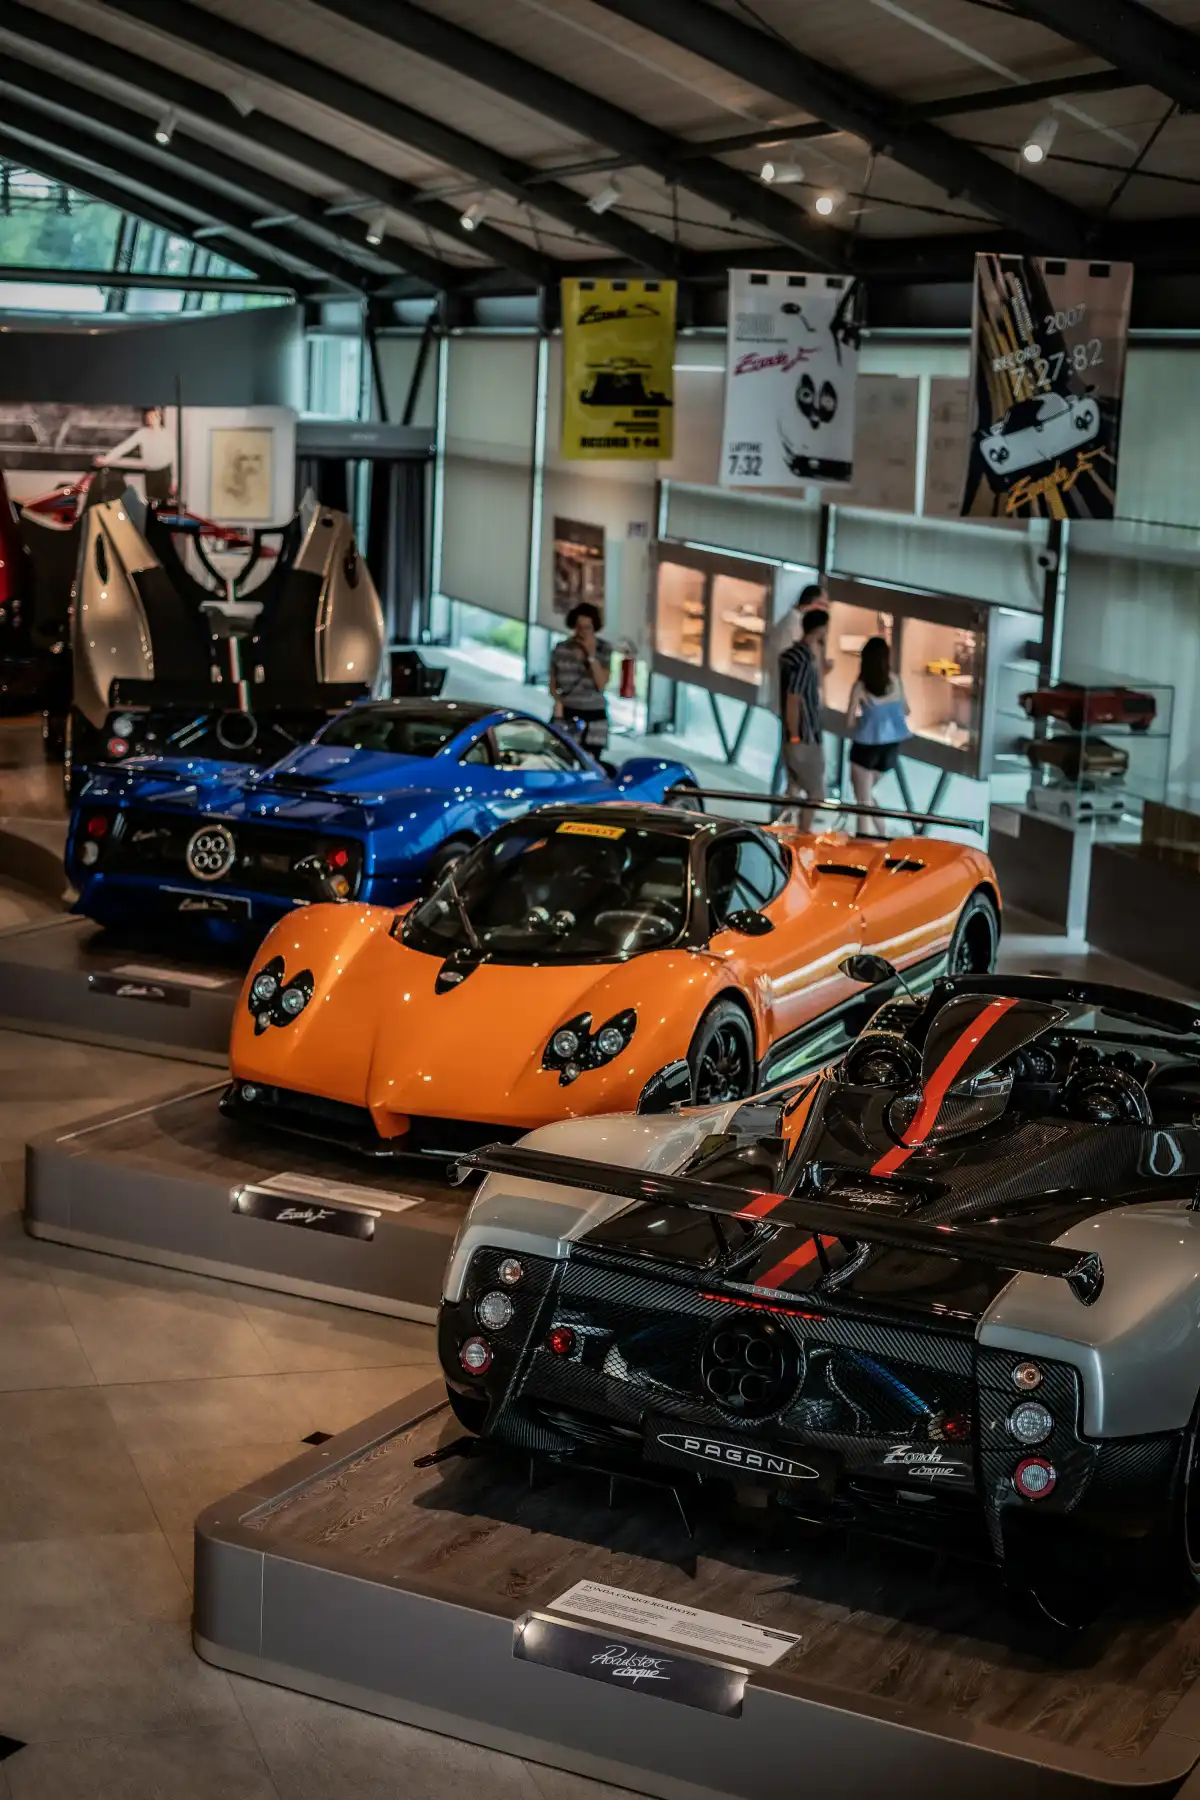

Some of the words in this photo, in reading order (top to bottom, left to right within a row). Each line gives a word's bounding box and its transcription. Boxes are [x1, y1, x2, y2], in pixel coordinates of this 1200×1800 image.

[1044, 301, 1086, 335] 2007
[1010, 338, 1105, 397] 7:27:82
[684, 1438, 793, 1474] PAGANI
[883, 1444, 964, 1465] Zonda
[590, 1644, 674, 1671] Roadster
[612, 1666, 671, 1685] cinque
